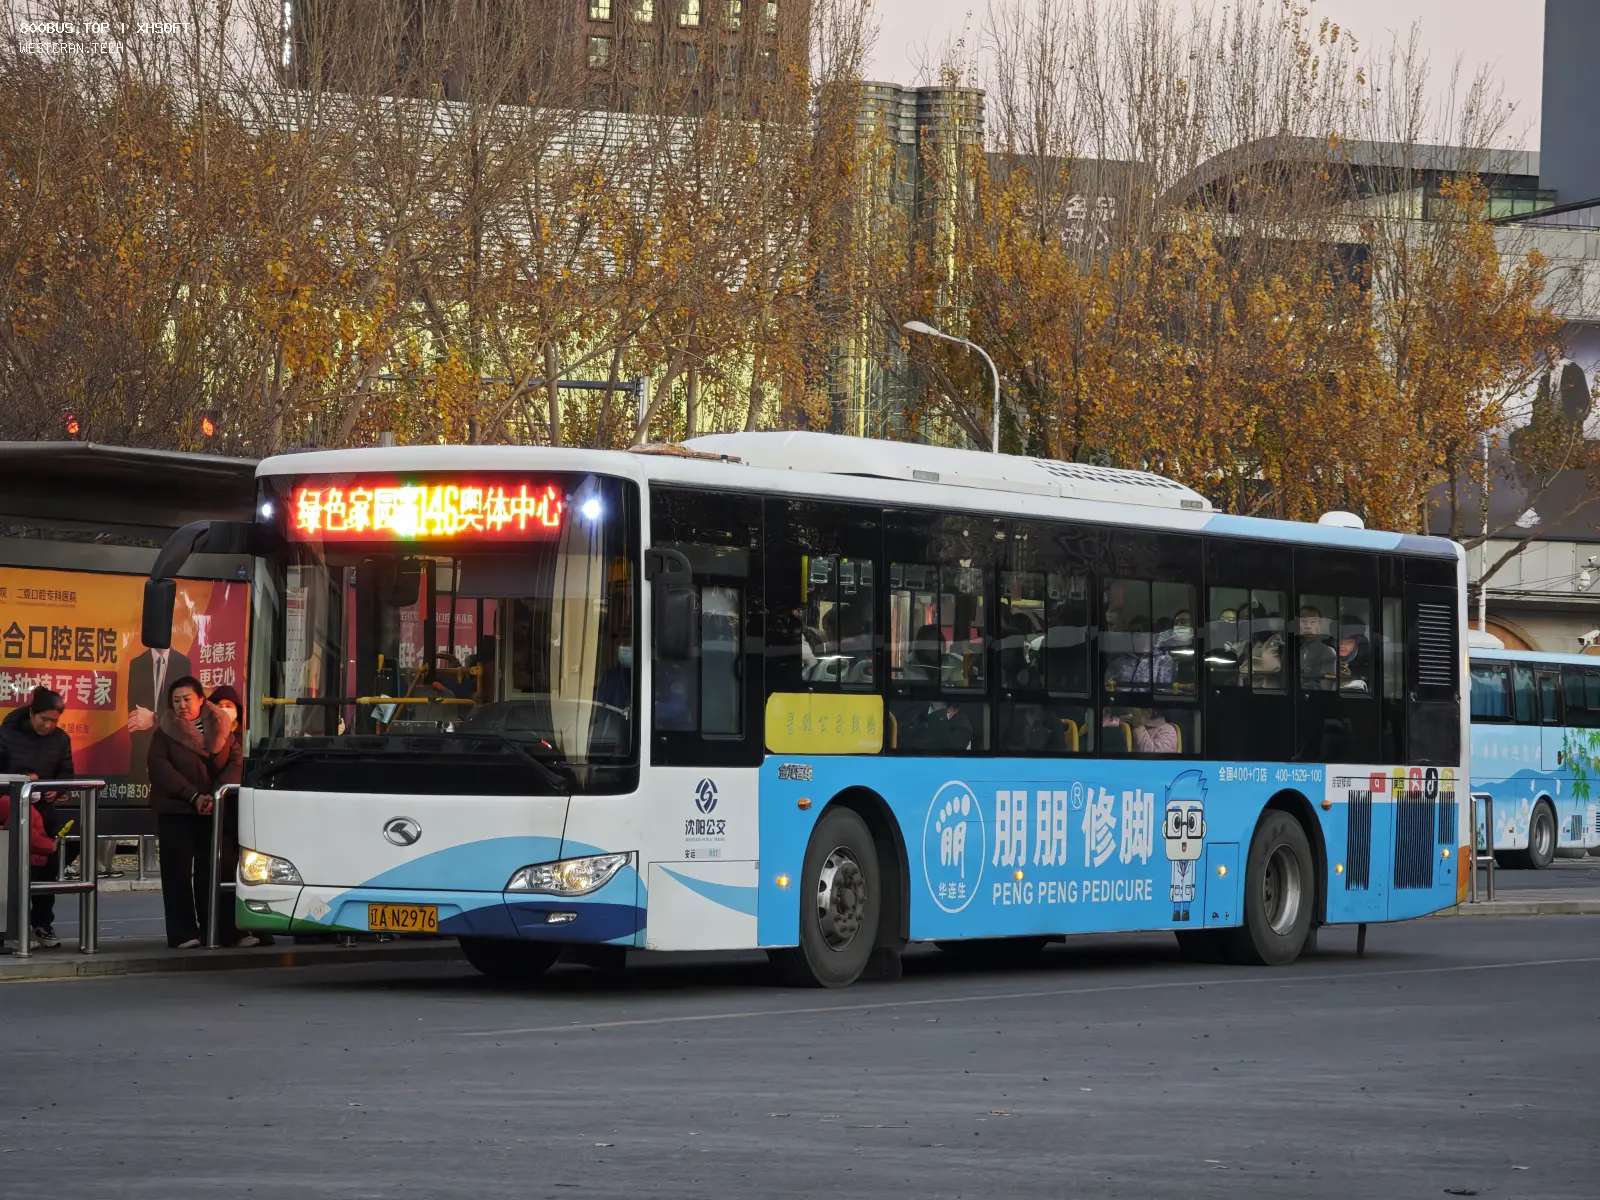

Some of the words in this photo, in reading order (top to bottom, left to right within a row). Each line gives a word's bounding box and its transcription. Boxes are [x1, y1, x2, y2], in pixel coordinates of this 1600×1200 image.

[16, 588, 77, 603] 二级口腔专科医院
[0, 621, 118, 664] 合口腔医院
[200, 641, 236, 664] 纯德系
[200, 666, 236, 688] 更安心
[1218, 766, 1268, 782] 全国400+门店
[685, 818, 726, 836] 沈阳公交
[938, 882, 967, 900] 华连生
[993, 881, 1034, 906] PENG
[1038, 880, 1078, 904] PENG
[1082, 878, 1153, 903] PEDICURE
